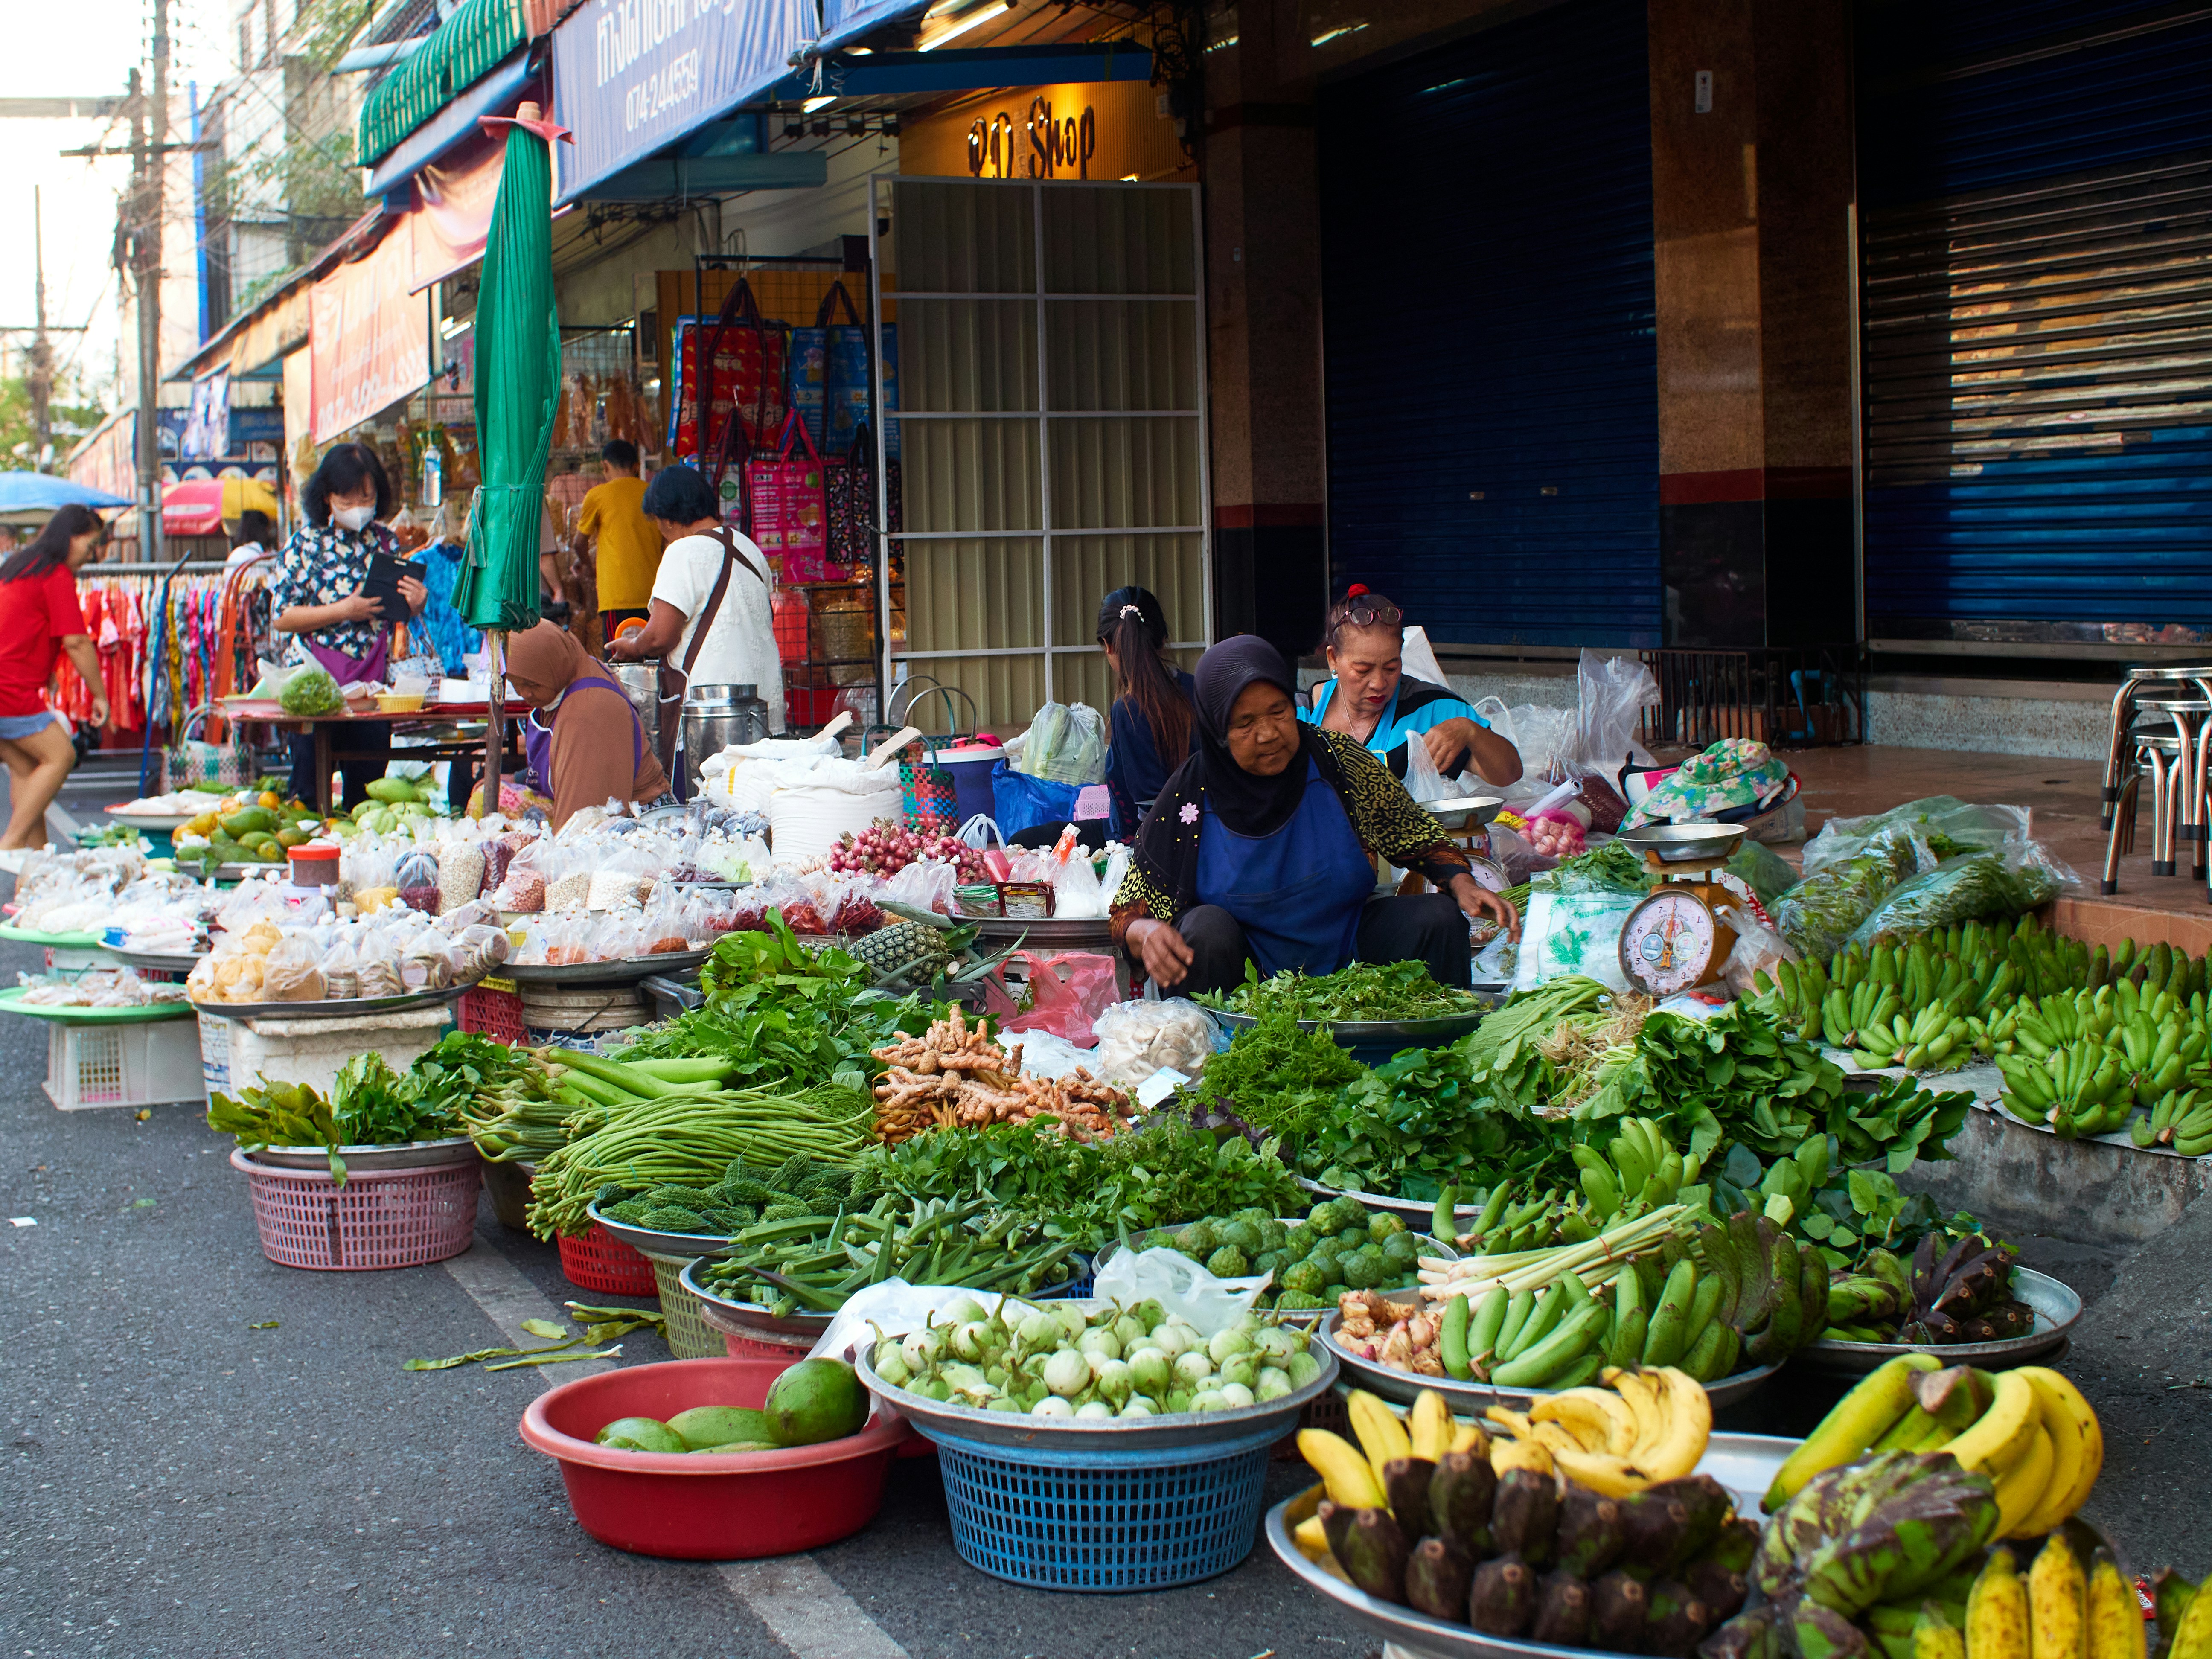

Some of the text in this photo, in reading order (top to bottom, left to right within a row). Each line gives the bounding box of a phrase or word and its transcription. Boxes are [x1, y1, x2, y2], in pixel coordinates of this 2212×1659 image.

[626, 47, 699, 133] 074-244559
[1027, 95, 1095, 180] Shop
[1653, 978, 1659, 986] 4
